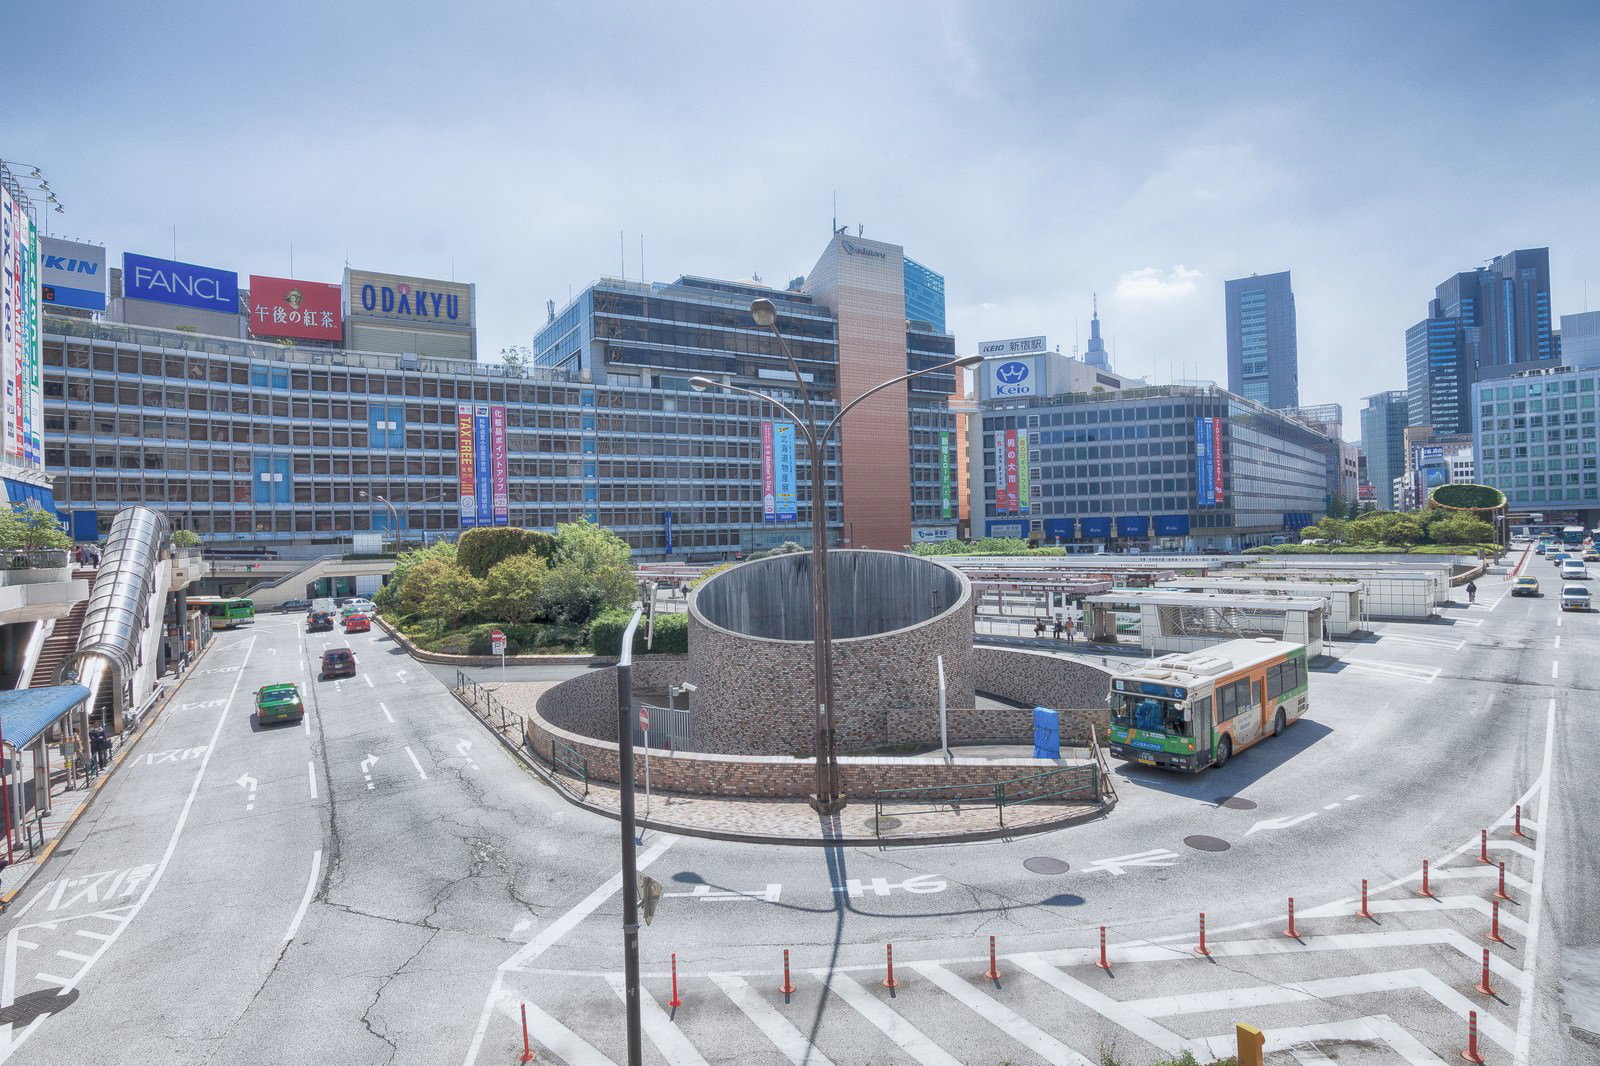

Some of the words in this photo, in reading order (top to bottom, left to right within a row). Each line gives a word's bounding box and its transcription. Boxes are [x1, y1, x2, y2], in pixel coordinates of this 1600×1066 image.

[4, 201, 12, 260] Tax
[135, 265, 231, 302] FANCL
[361, 283, 458, 320] ODAKYU
[254, 303, 334, 329] 午後の紅茶
[983, 344, 1005, 353] KEIO
[1009, 339, 1042, 352] 新宿駅
[996, 384, 1030, 395] Keio
[460, 416, 471, 437] TAX
[461, 439, 473, 464] FREE
[1007, 438, 1016, 483] 男の大市
